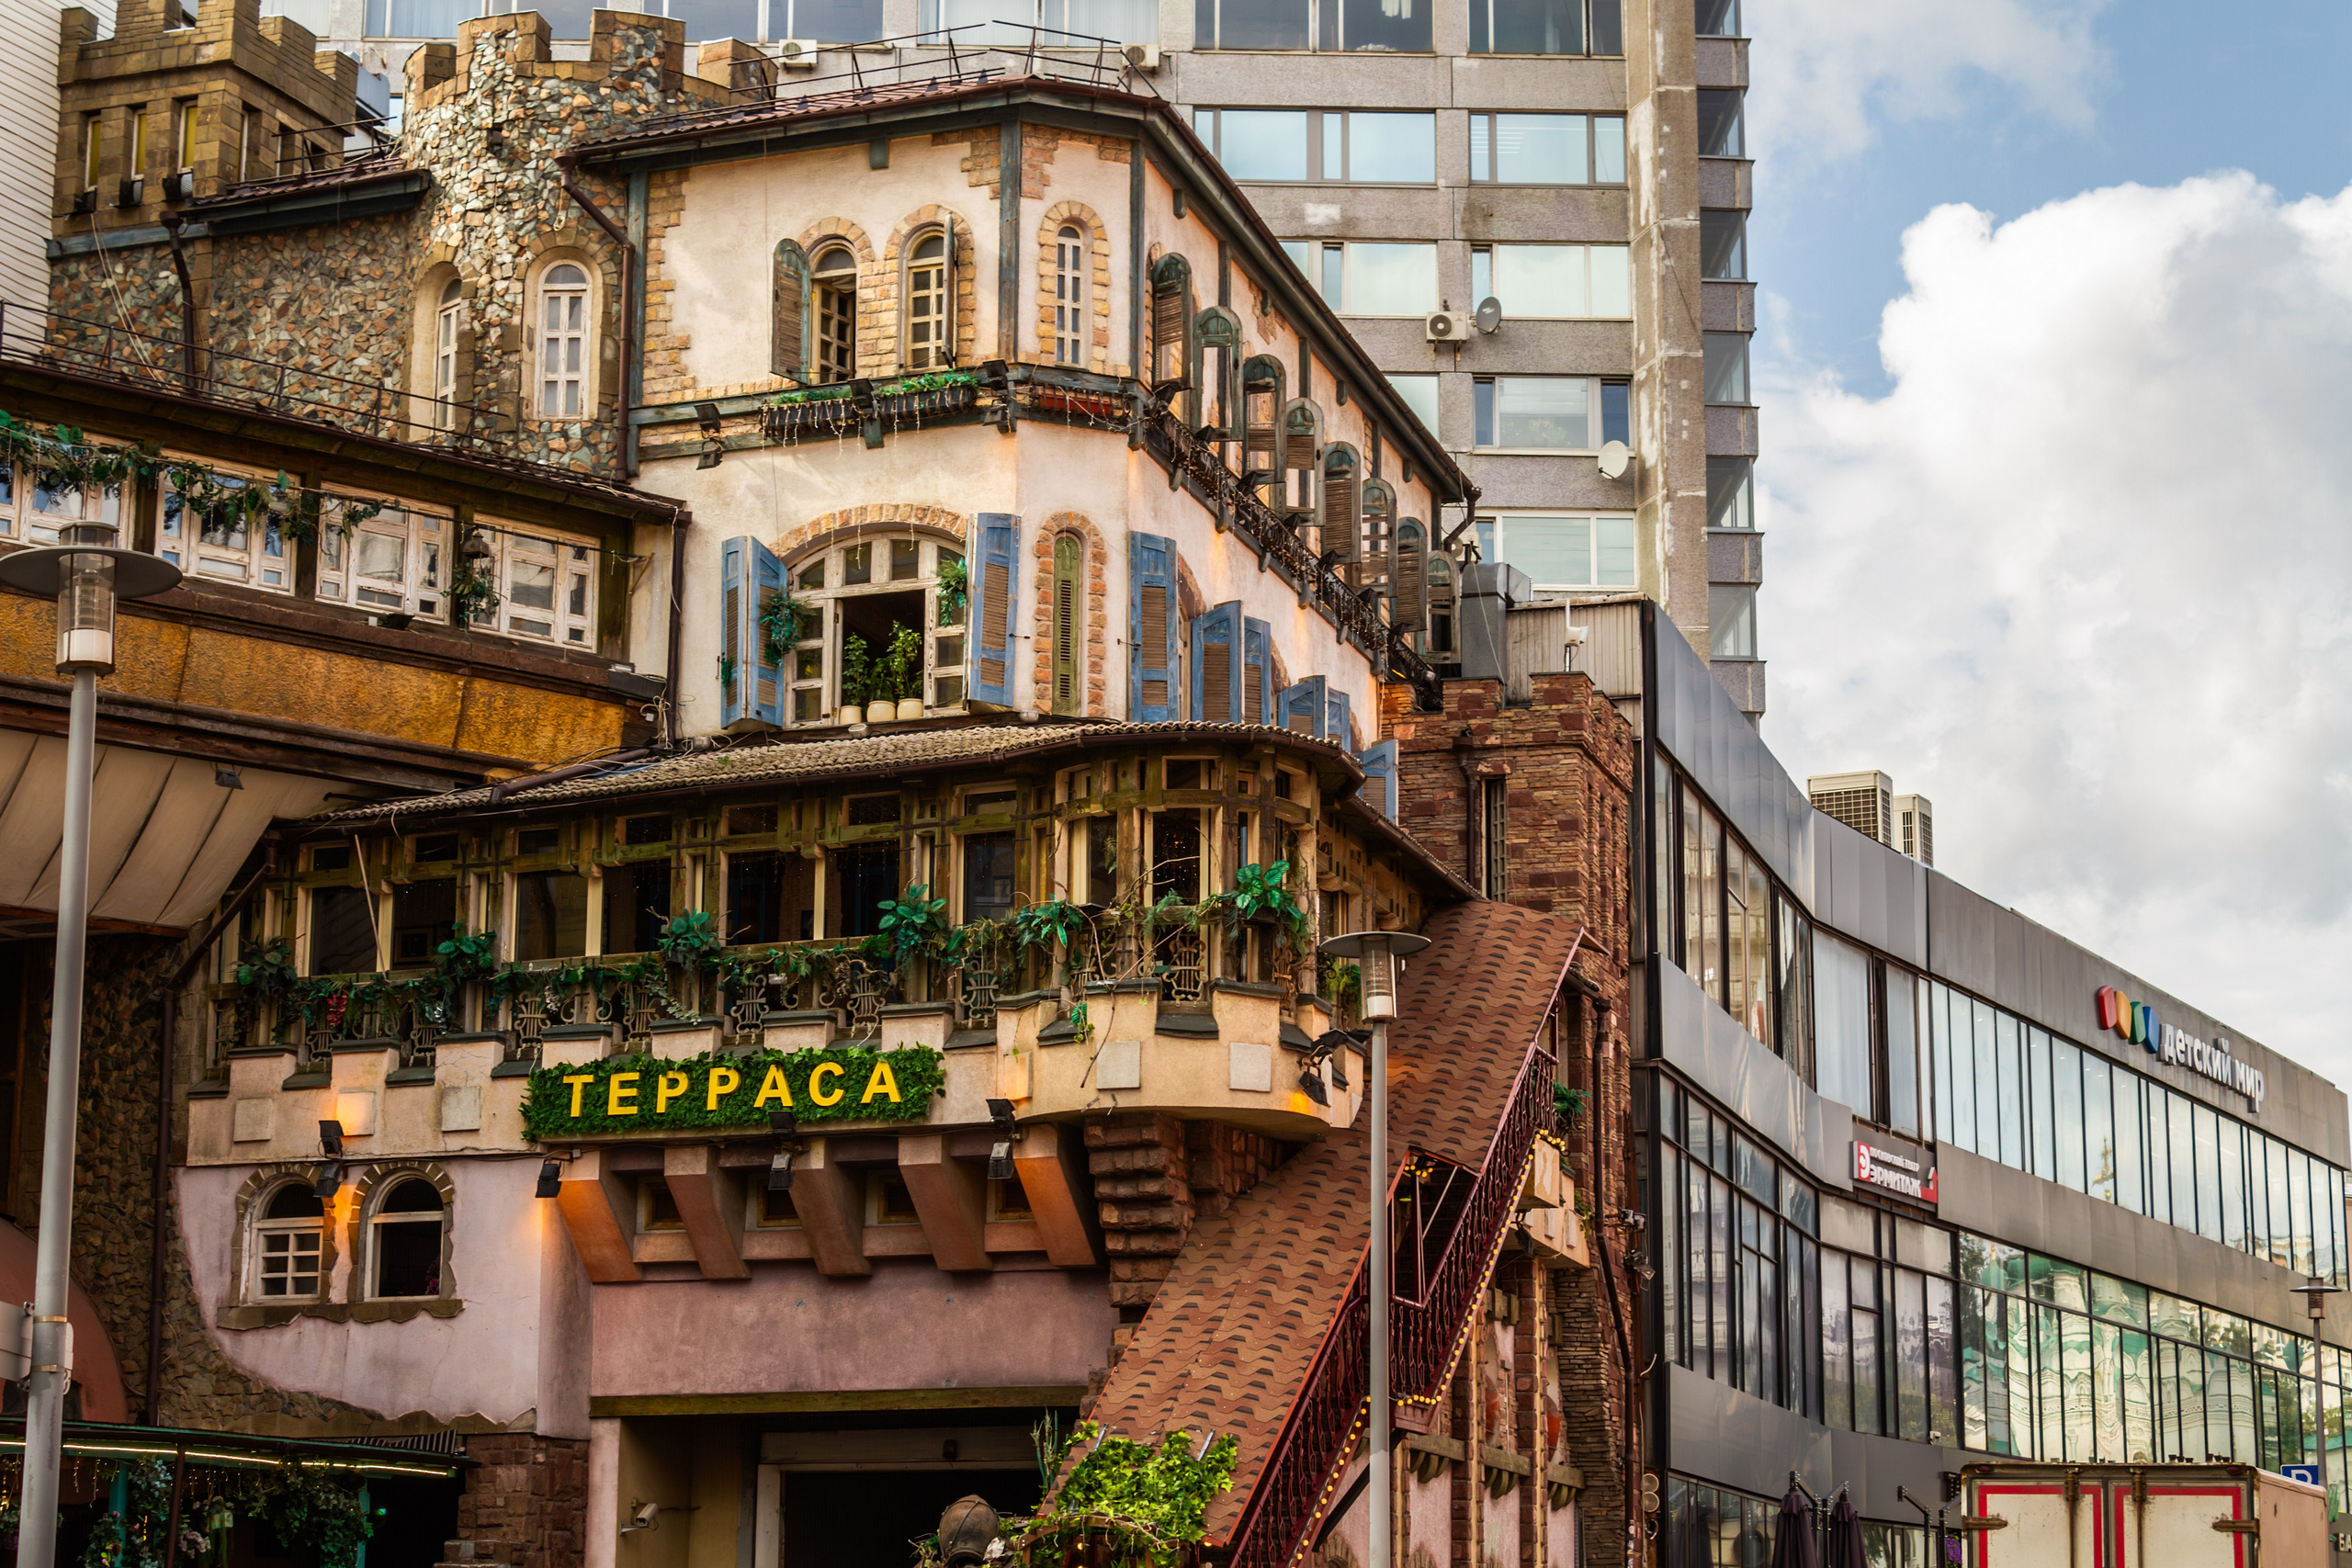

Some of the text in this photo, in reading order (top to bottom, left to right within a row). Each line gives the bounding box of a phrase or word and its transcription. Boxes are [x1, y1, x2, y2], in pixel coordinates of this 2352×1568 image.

[562, 1060, 902, 1118] ТЕРРАСА
[2161, 1023, 2264, 1113] детский мир
[1870, 1164, 1922, 1198] ЭРМИТАЖ
